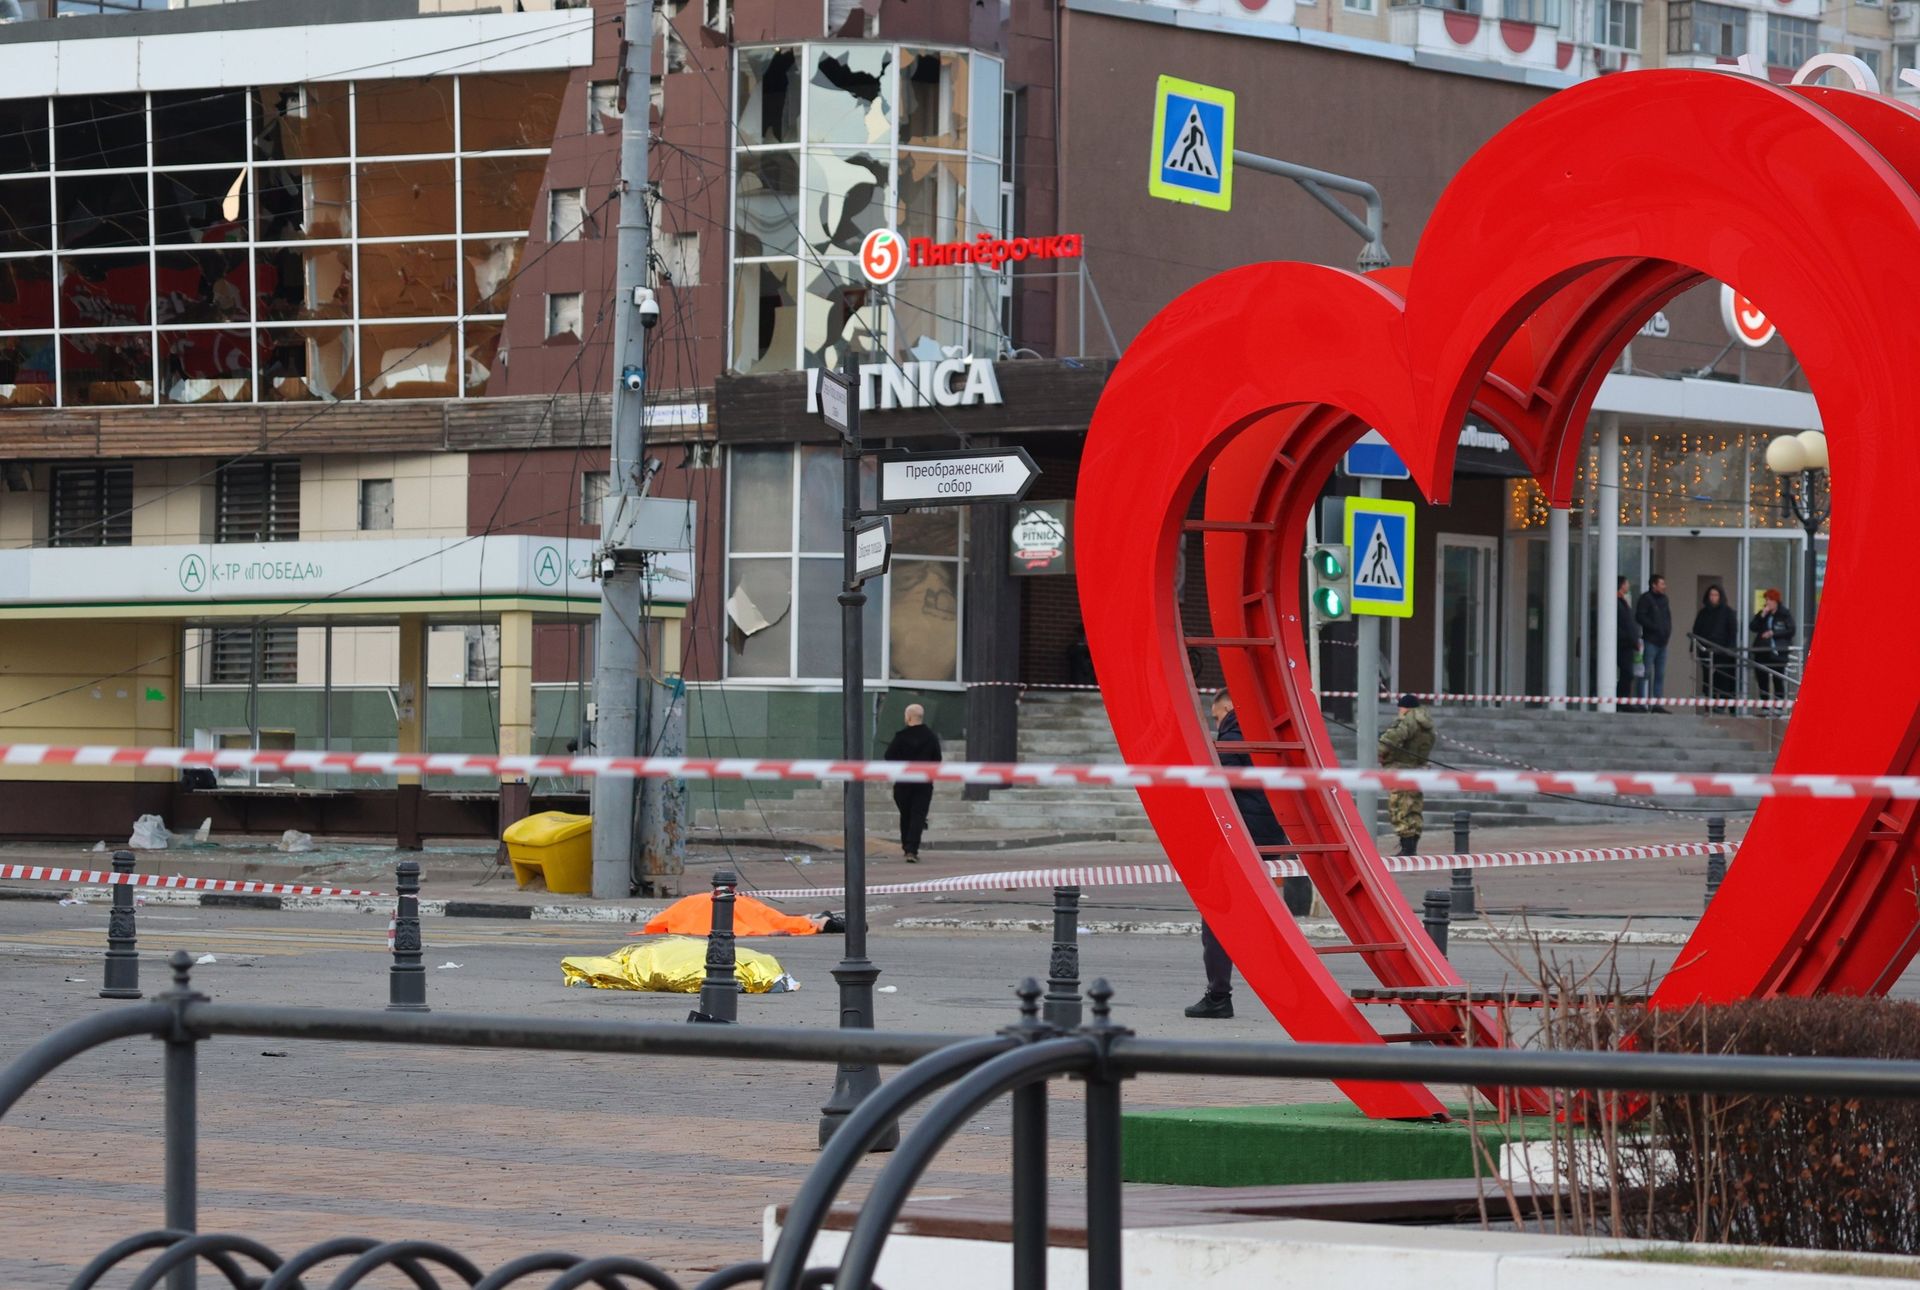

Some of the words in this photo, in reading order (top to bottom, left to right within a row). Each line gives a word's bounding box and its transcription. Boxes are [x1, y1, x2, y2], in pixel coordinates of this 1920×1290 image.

[870, 239, 893, 274] 5
[909, 233, 1083, 270] Пятёрочка
[906, 460, 1004, 479] Преображенский
[938, 479, 972, 494] собор
[212, 563, 240, 581] К-ТР
[245, 562, 323, 581] «ПОБЕДА»
